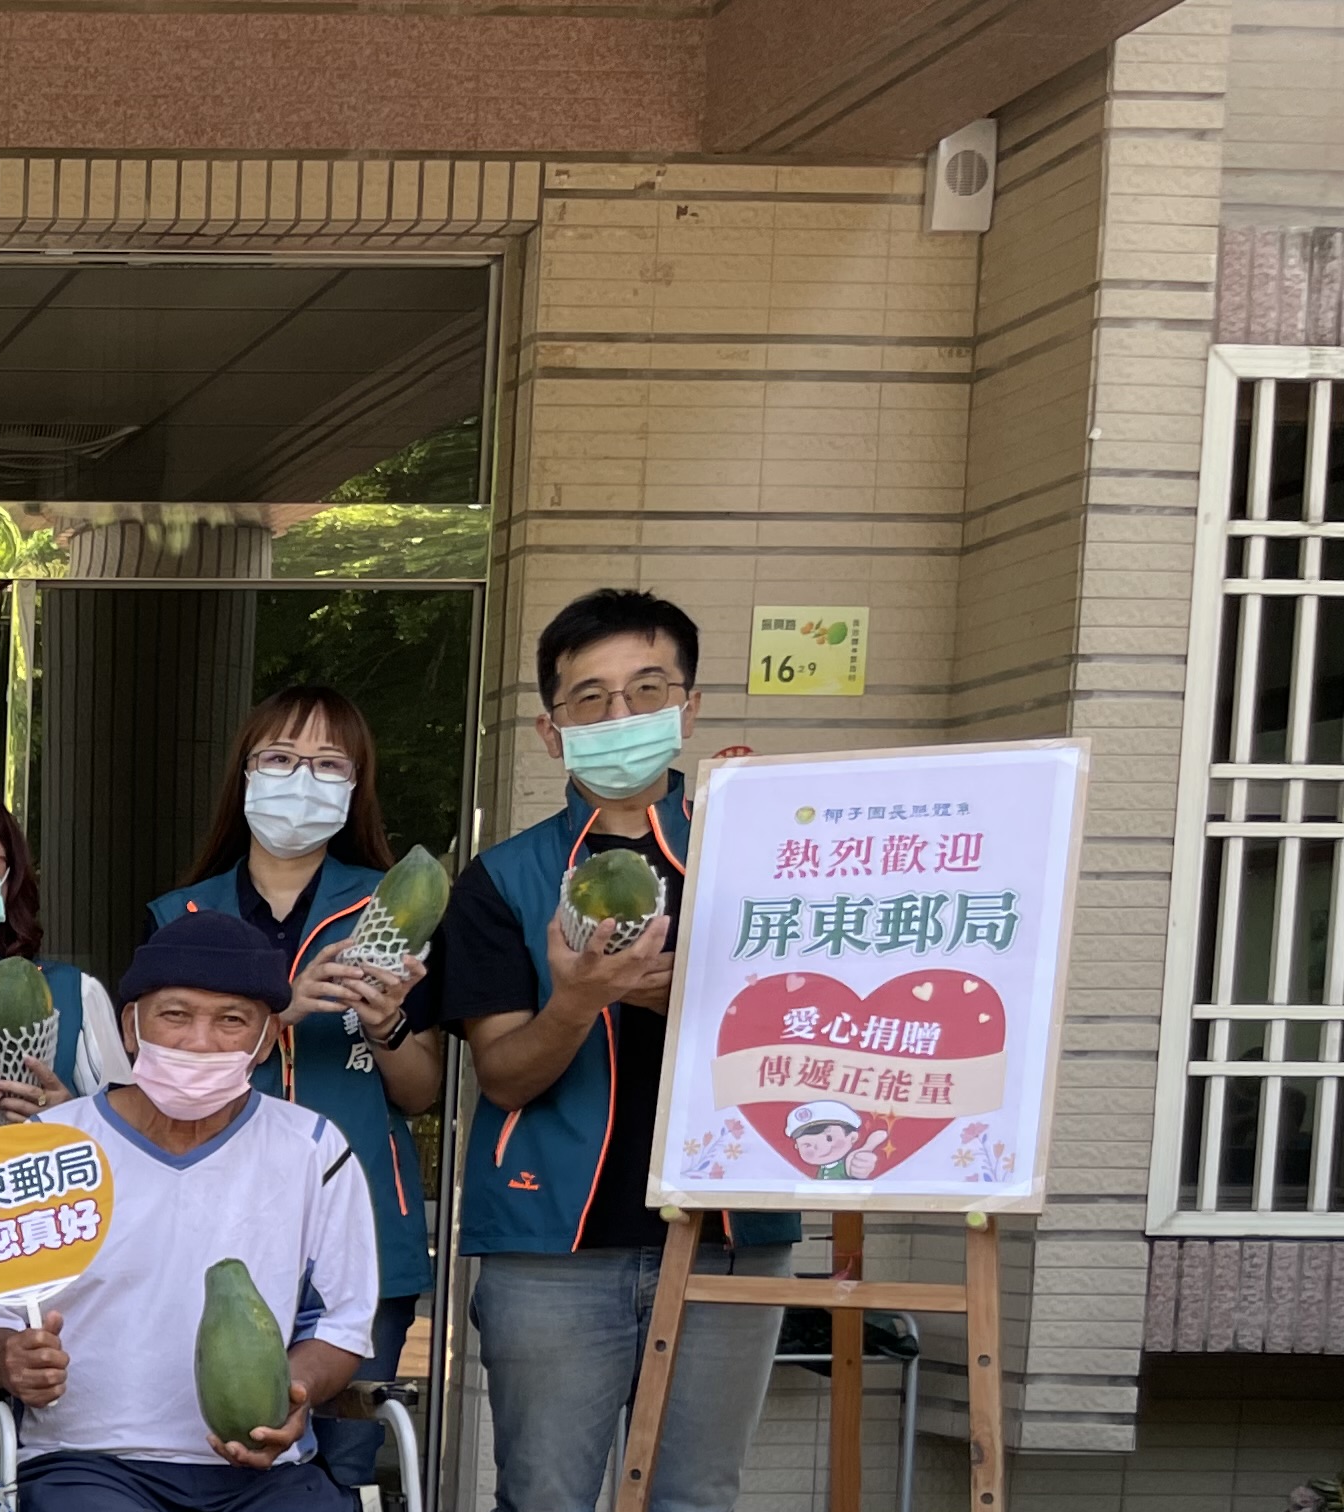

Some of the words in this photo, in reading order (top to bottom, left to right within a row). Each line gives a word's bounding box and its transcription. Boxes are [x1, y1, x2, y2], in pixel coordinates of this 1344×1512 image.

[773, 831, 985, 880] 熱烈歡迎
[732, 891, 1019, 960] 屏東郵局
[780, 1006, 942, 1057] 愛心捐贈
[756, 1055, 956, 1106] 傳遞正能量
